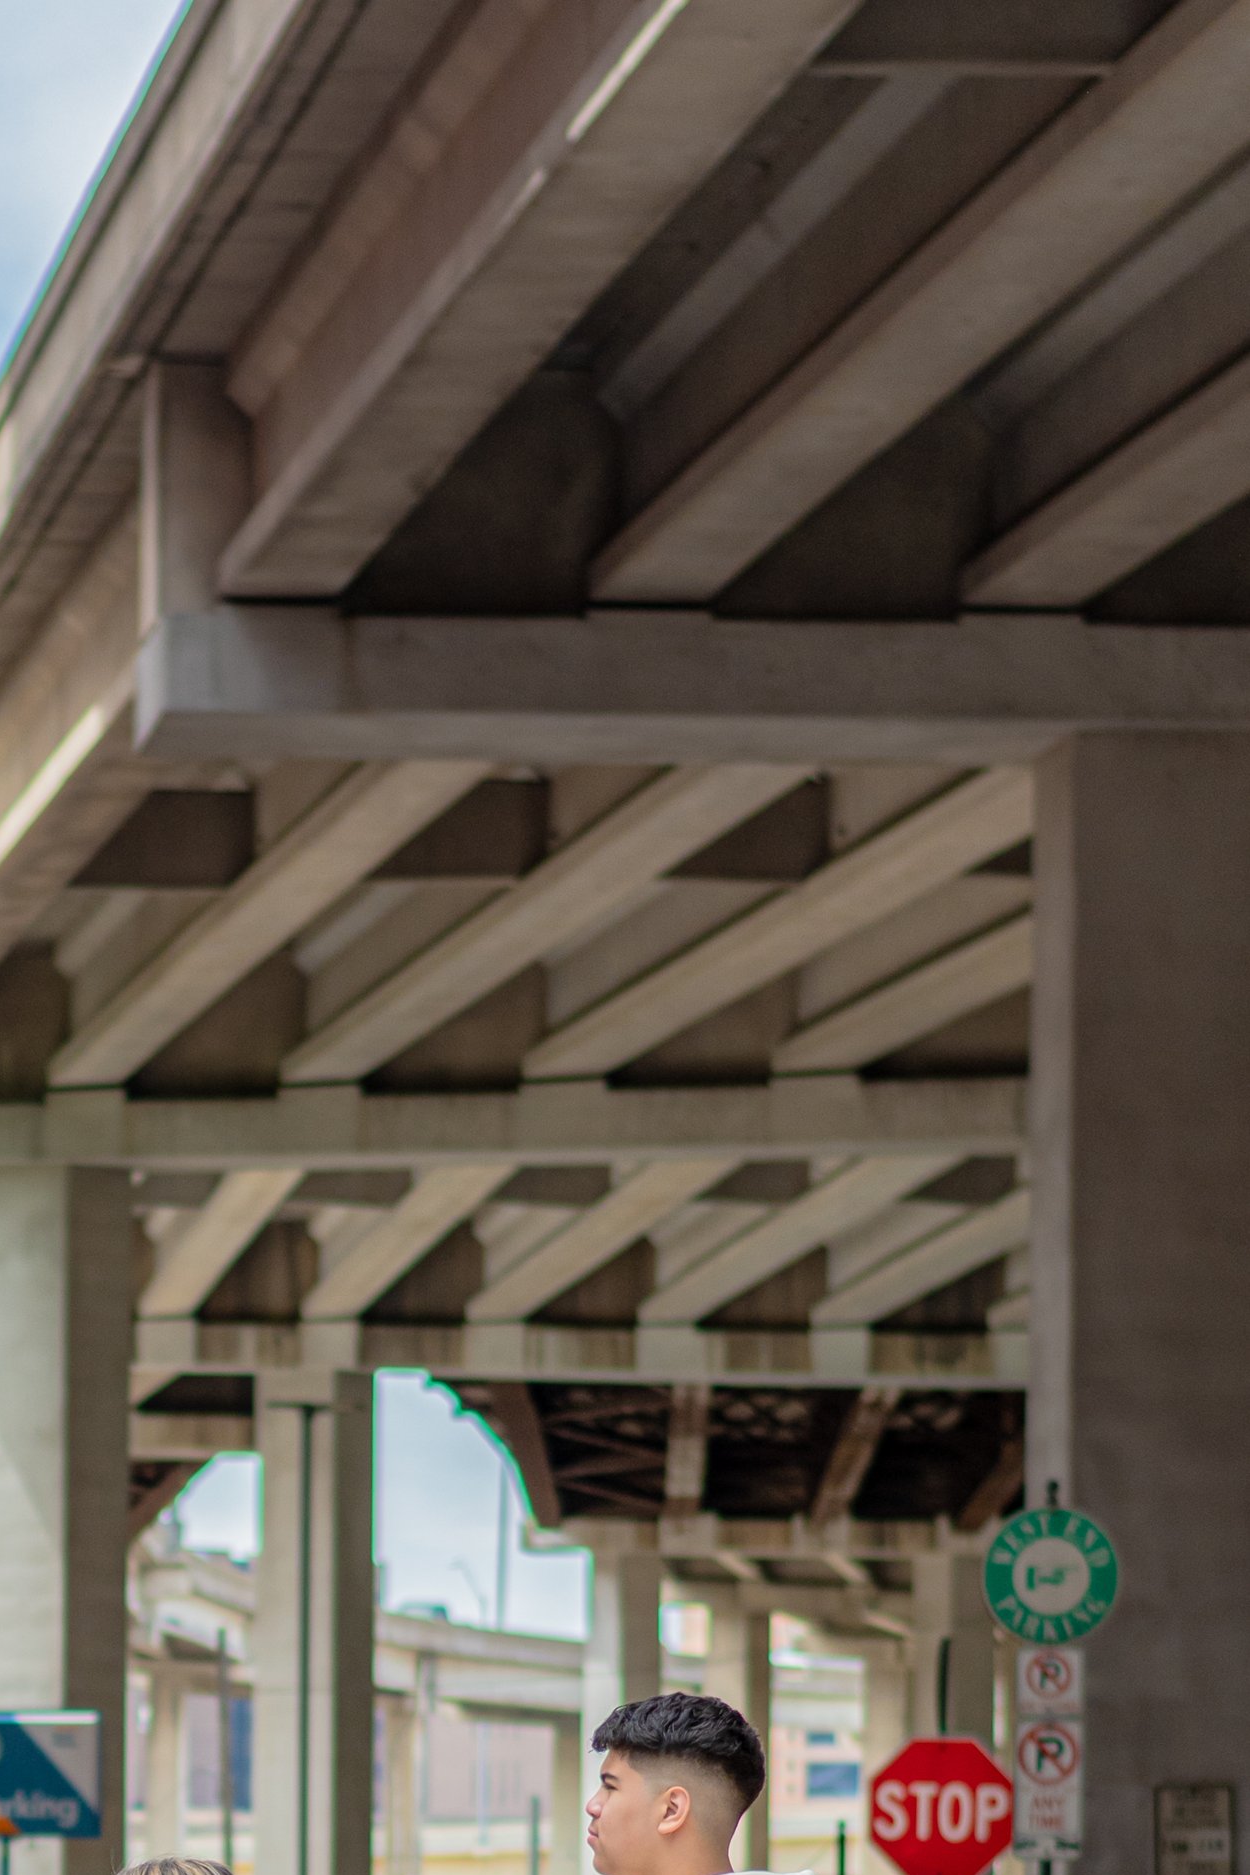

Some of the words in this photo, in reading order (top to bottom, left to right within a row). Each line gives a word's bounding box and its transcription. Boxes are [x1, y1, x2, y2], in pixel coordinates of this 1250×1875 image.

[992, 1512, 1050, 1565] WEST
[1062, 1514, 1111, 1568] END
[997, 1596, 1106, 1640] PARKING
[1036, 1736, 1065, 1773] P
[873, 1779, 1010, 1844] STOP
